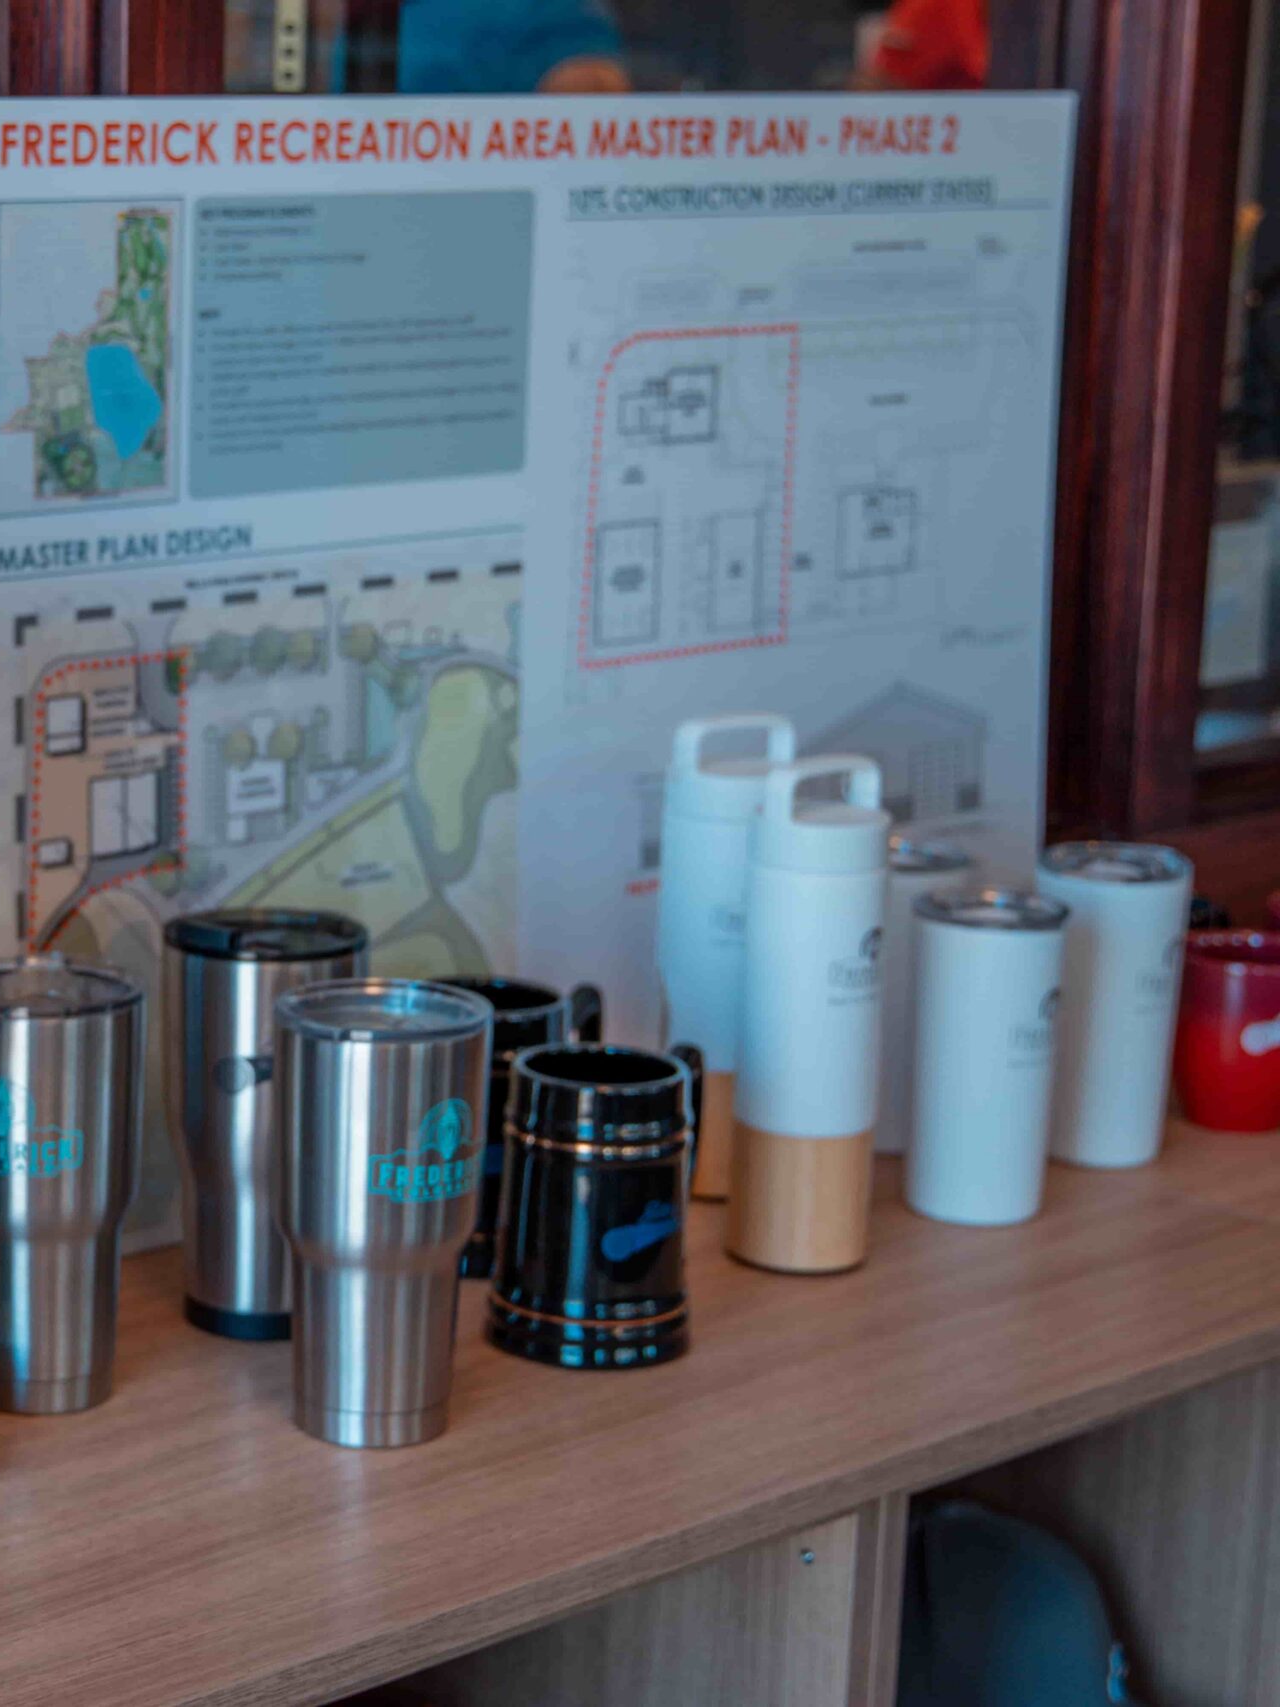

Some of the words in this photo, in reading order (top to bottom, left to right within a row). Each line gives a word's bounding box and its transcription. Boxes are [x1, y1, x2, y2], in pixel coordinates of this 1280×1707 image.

[0, 121, 219, 168] FREDERICK
[232, 119, 471, 165] RECREATION
[482, 117, 577, 161] AREA
[587, 116, 717, 160] MASTER
[725, 117, 810, 157] PLAN
[838, 115, 933, 156] PHASE
[937, 115, 961, 155] 2
[96, 532, 158, 562] PLAN
[165, 525, 252, 557] DESIGN
